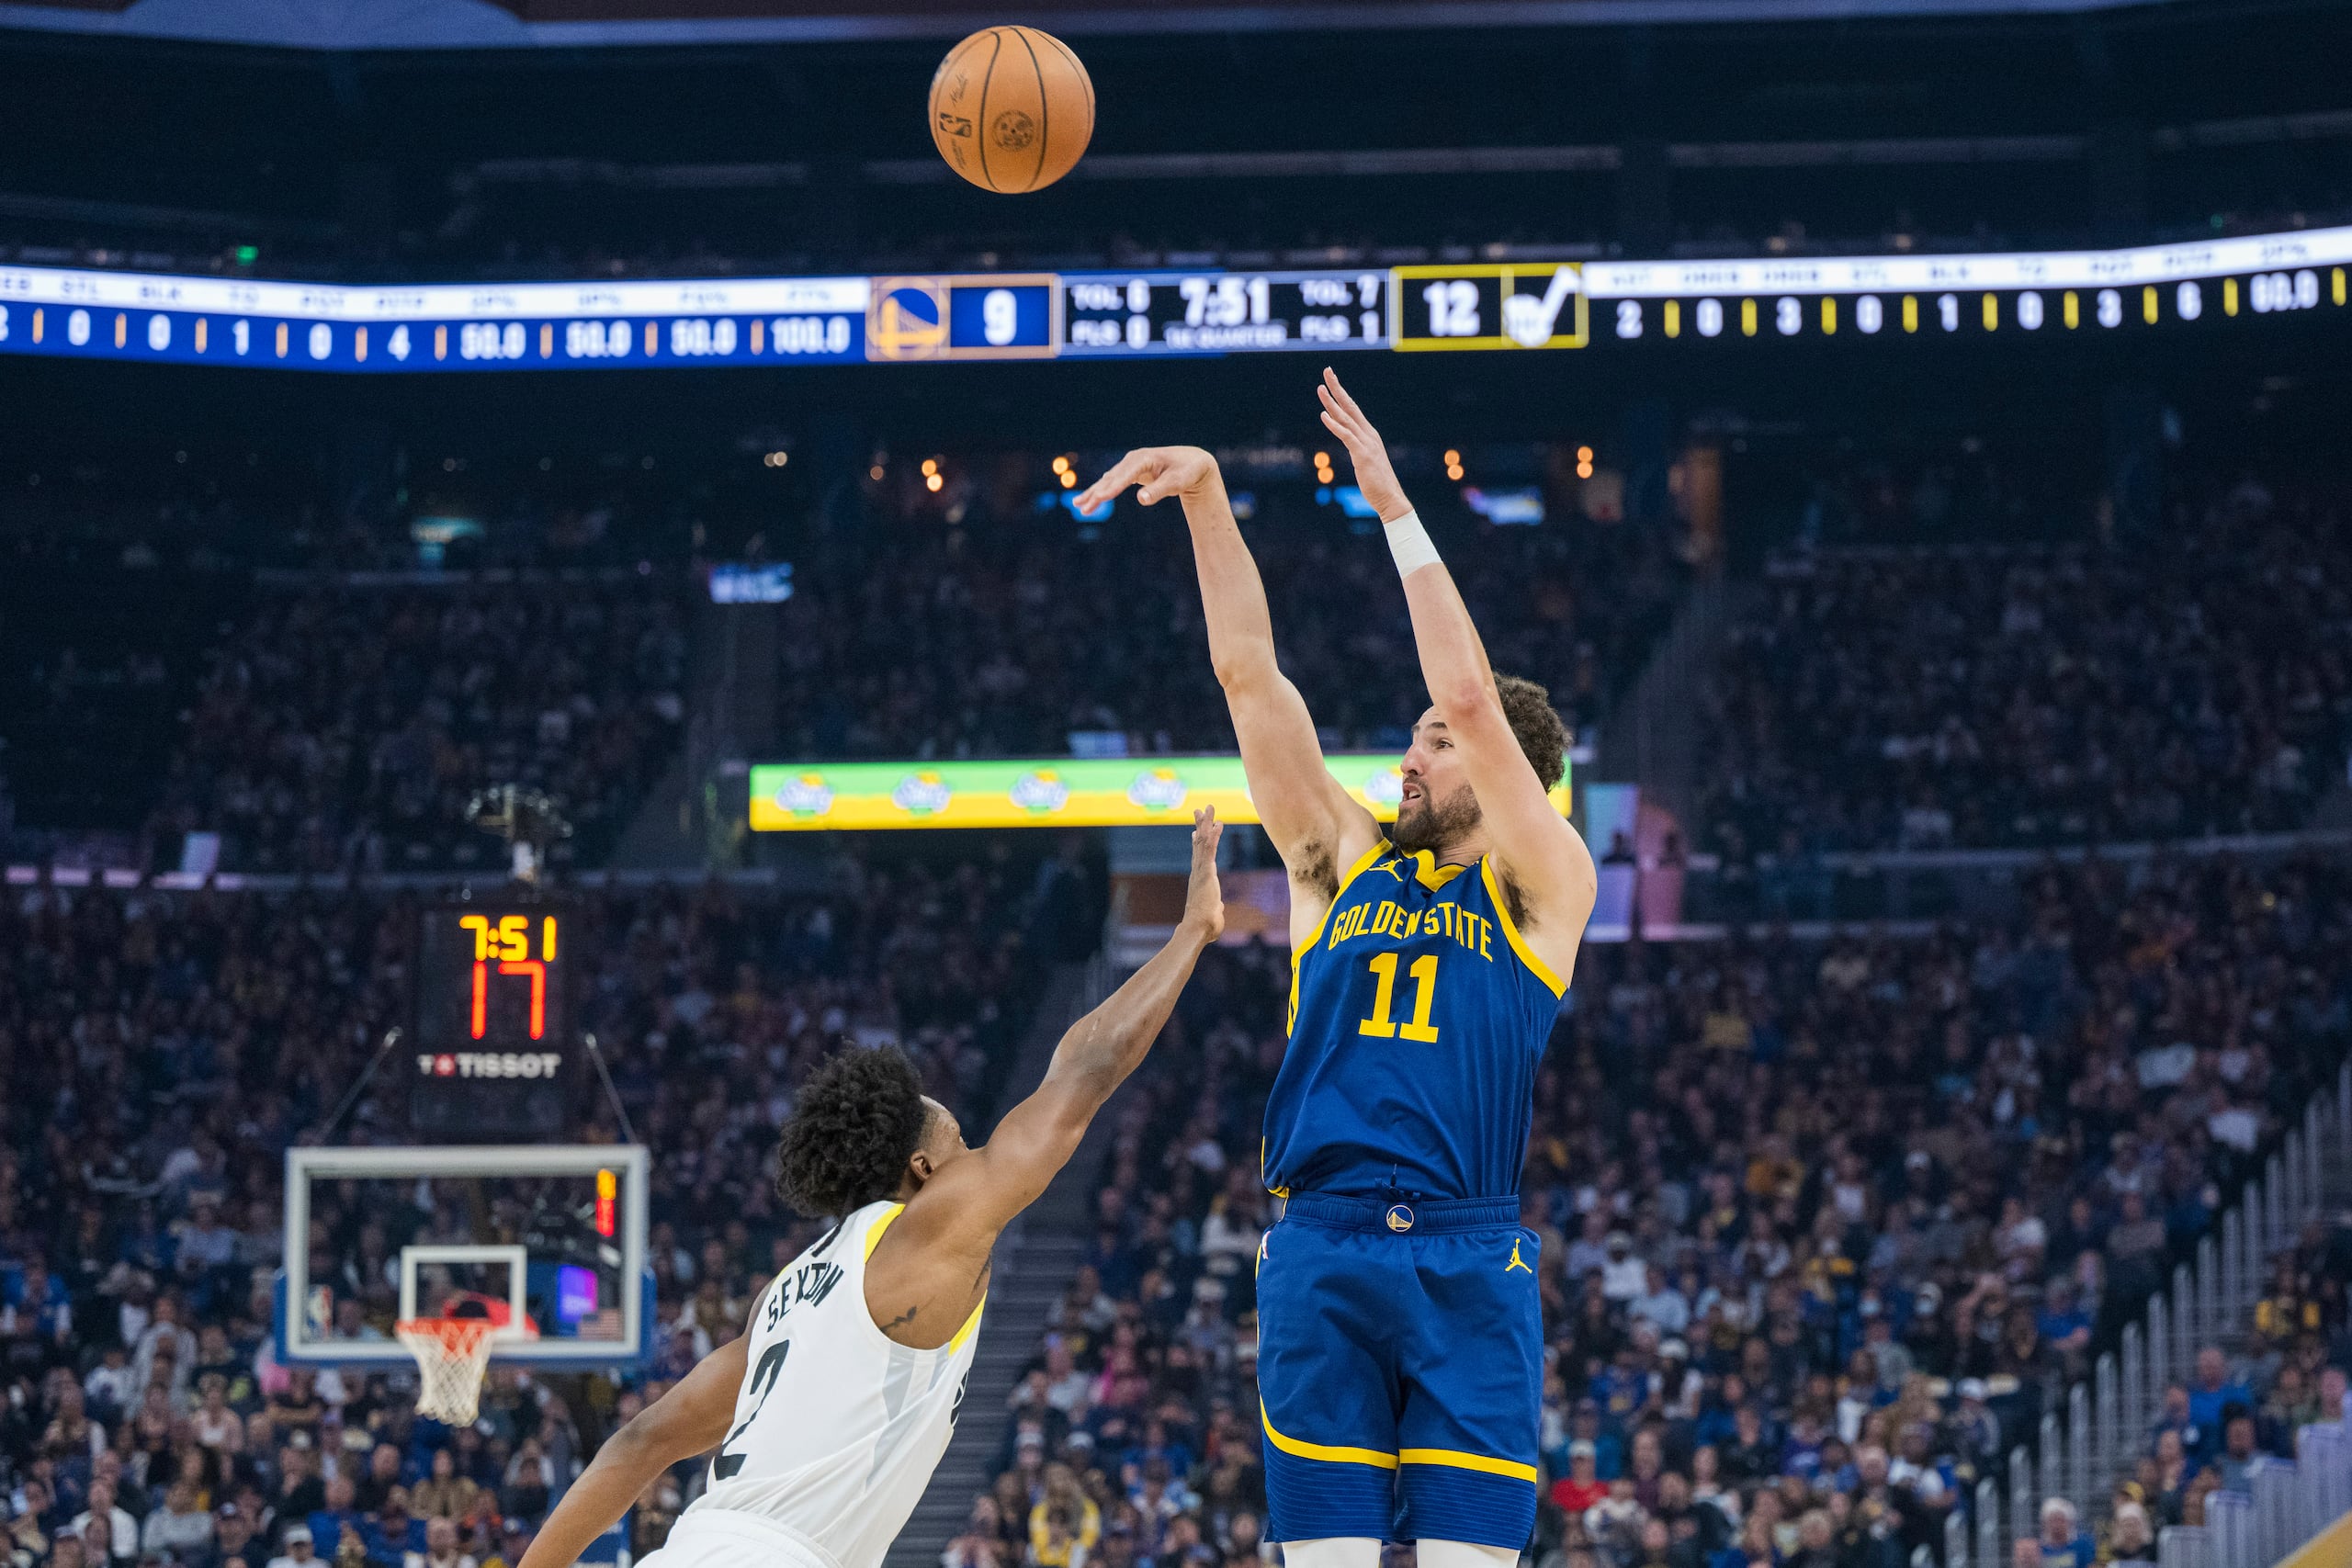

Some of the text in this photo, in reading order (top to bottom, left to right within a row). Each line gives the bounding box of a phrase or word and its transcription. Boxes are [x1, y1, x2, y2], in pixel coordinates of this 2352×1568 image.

[983, 289, 1017, 346] 9
[1180, 276, 1269, 328] 7:51
[1357, 274, 1380, 310] 7
[1423, 279, 1481, 337] 12
[1616, 299, 1643, 339] 2
[1696, 298, 1724, 337] 0
[1776, 296, 1803, 336] 3
[1856, 294, 1883, 333] 0
[1937, 292, 1959, 332] 1
[2017, 290, 2044, 331] 0
[2098, 288, 2123, 329] 3
[68, 309, 91, 346] 0
[148, 313, 172, 351] 0
[232, 319, 250, 356] 1
[308, 322, 333, 361] 0
[387, 323, 412, 361] 4
[771, 314, 851, 354] 100.0
[1359, 310, 1380, 344] 1
[459, 915, 557, 962] 7:51
[1328, 900, 1493, 963] GOLDEN STATE
[470, 960, 546, 1040] 17
[1358, 952, 1439, 1043] 11
[457, 1053, 561, 1078] TISSOT
[713, 1338, 790, 1481] 2
